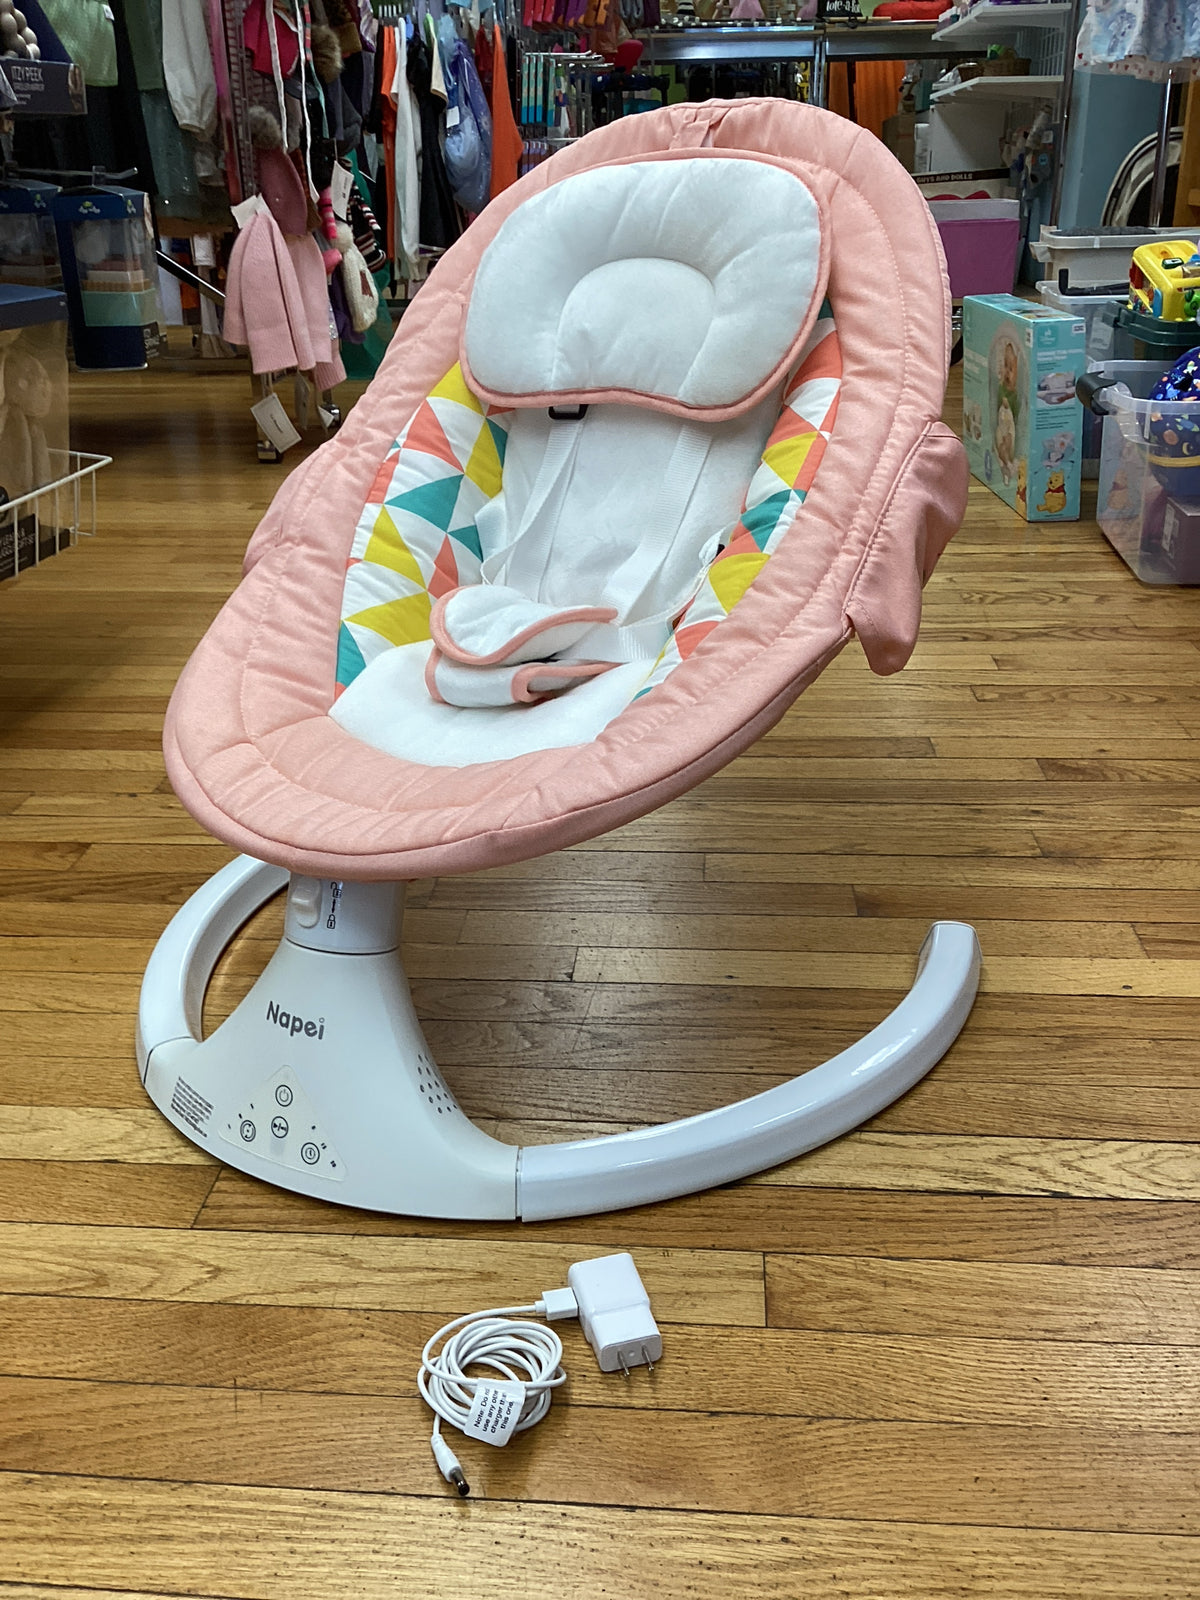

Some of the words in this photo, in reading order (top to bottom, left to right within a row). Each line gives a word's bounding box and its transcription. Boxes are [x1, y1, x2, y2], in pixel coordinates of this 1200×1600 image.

[916, 176, 935, 184] GUYS
[266, 1000, 325, 1040] Napei
[481, 1396, 488, 1407] Do
[482, 1418, 491, 1432] use
[488, 1404, 497, 1418] any
[491, 1406, 503, 1433] charger
[500, 1416, 509, 1429] this
